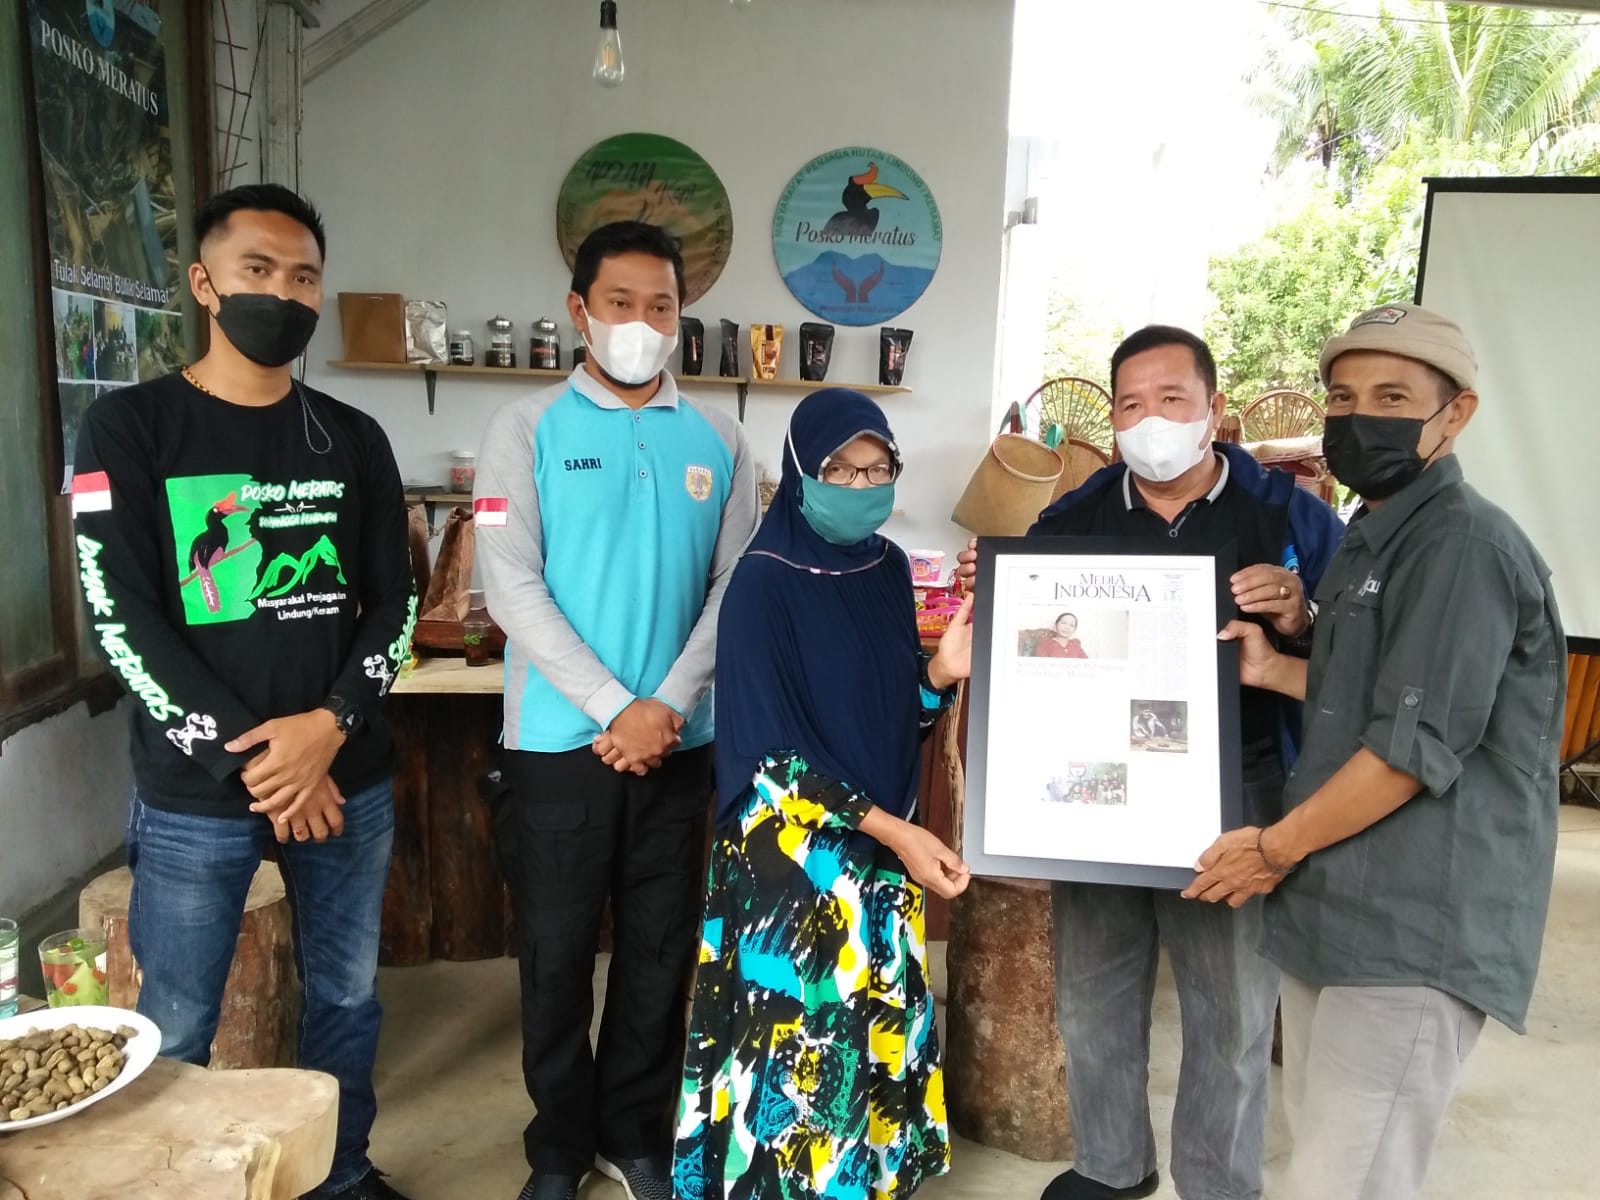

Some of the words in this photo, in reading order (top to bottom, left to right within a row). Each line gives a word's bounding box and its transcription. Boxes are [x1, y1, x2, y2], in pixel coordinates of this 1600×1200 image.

[40, 18, 94, 75] POSKO
[97, 55, 159, 116] MERATUS
[795, 221, 845, 243] Posko
[848, 225, 916, 246] Meratus
[80, 265, 113, 291] Selamat
[135, 281, 170, 303] Selamat
[564, 457, 602, 471] SAHRI
[240, 483, 287, 502] POSKO
[287, 479, 346, 501] MERATUS
[1080, 573, 1127, 585] MEDIA
[257, 593, 306, 609] Masyarakat
[1053, 581, 1152, 603] INDONESIA
[94, 623, 184, 721] MERATUS
